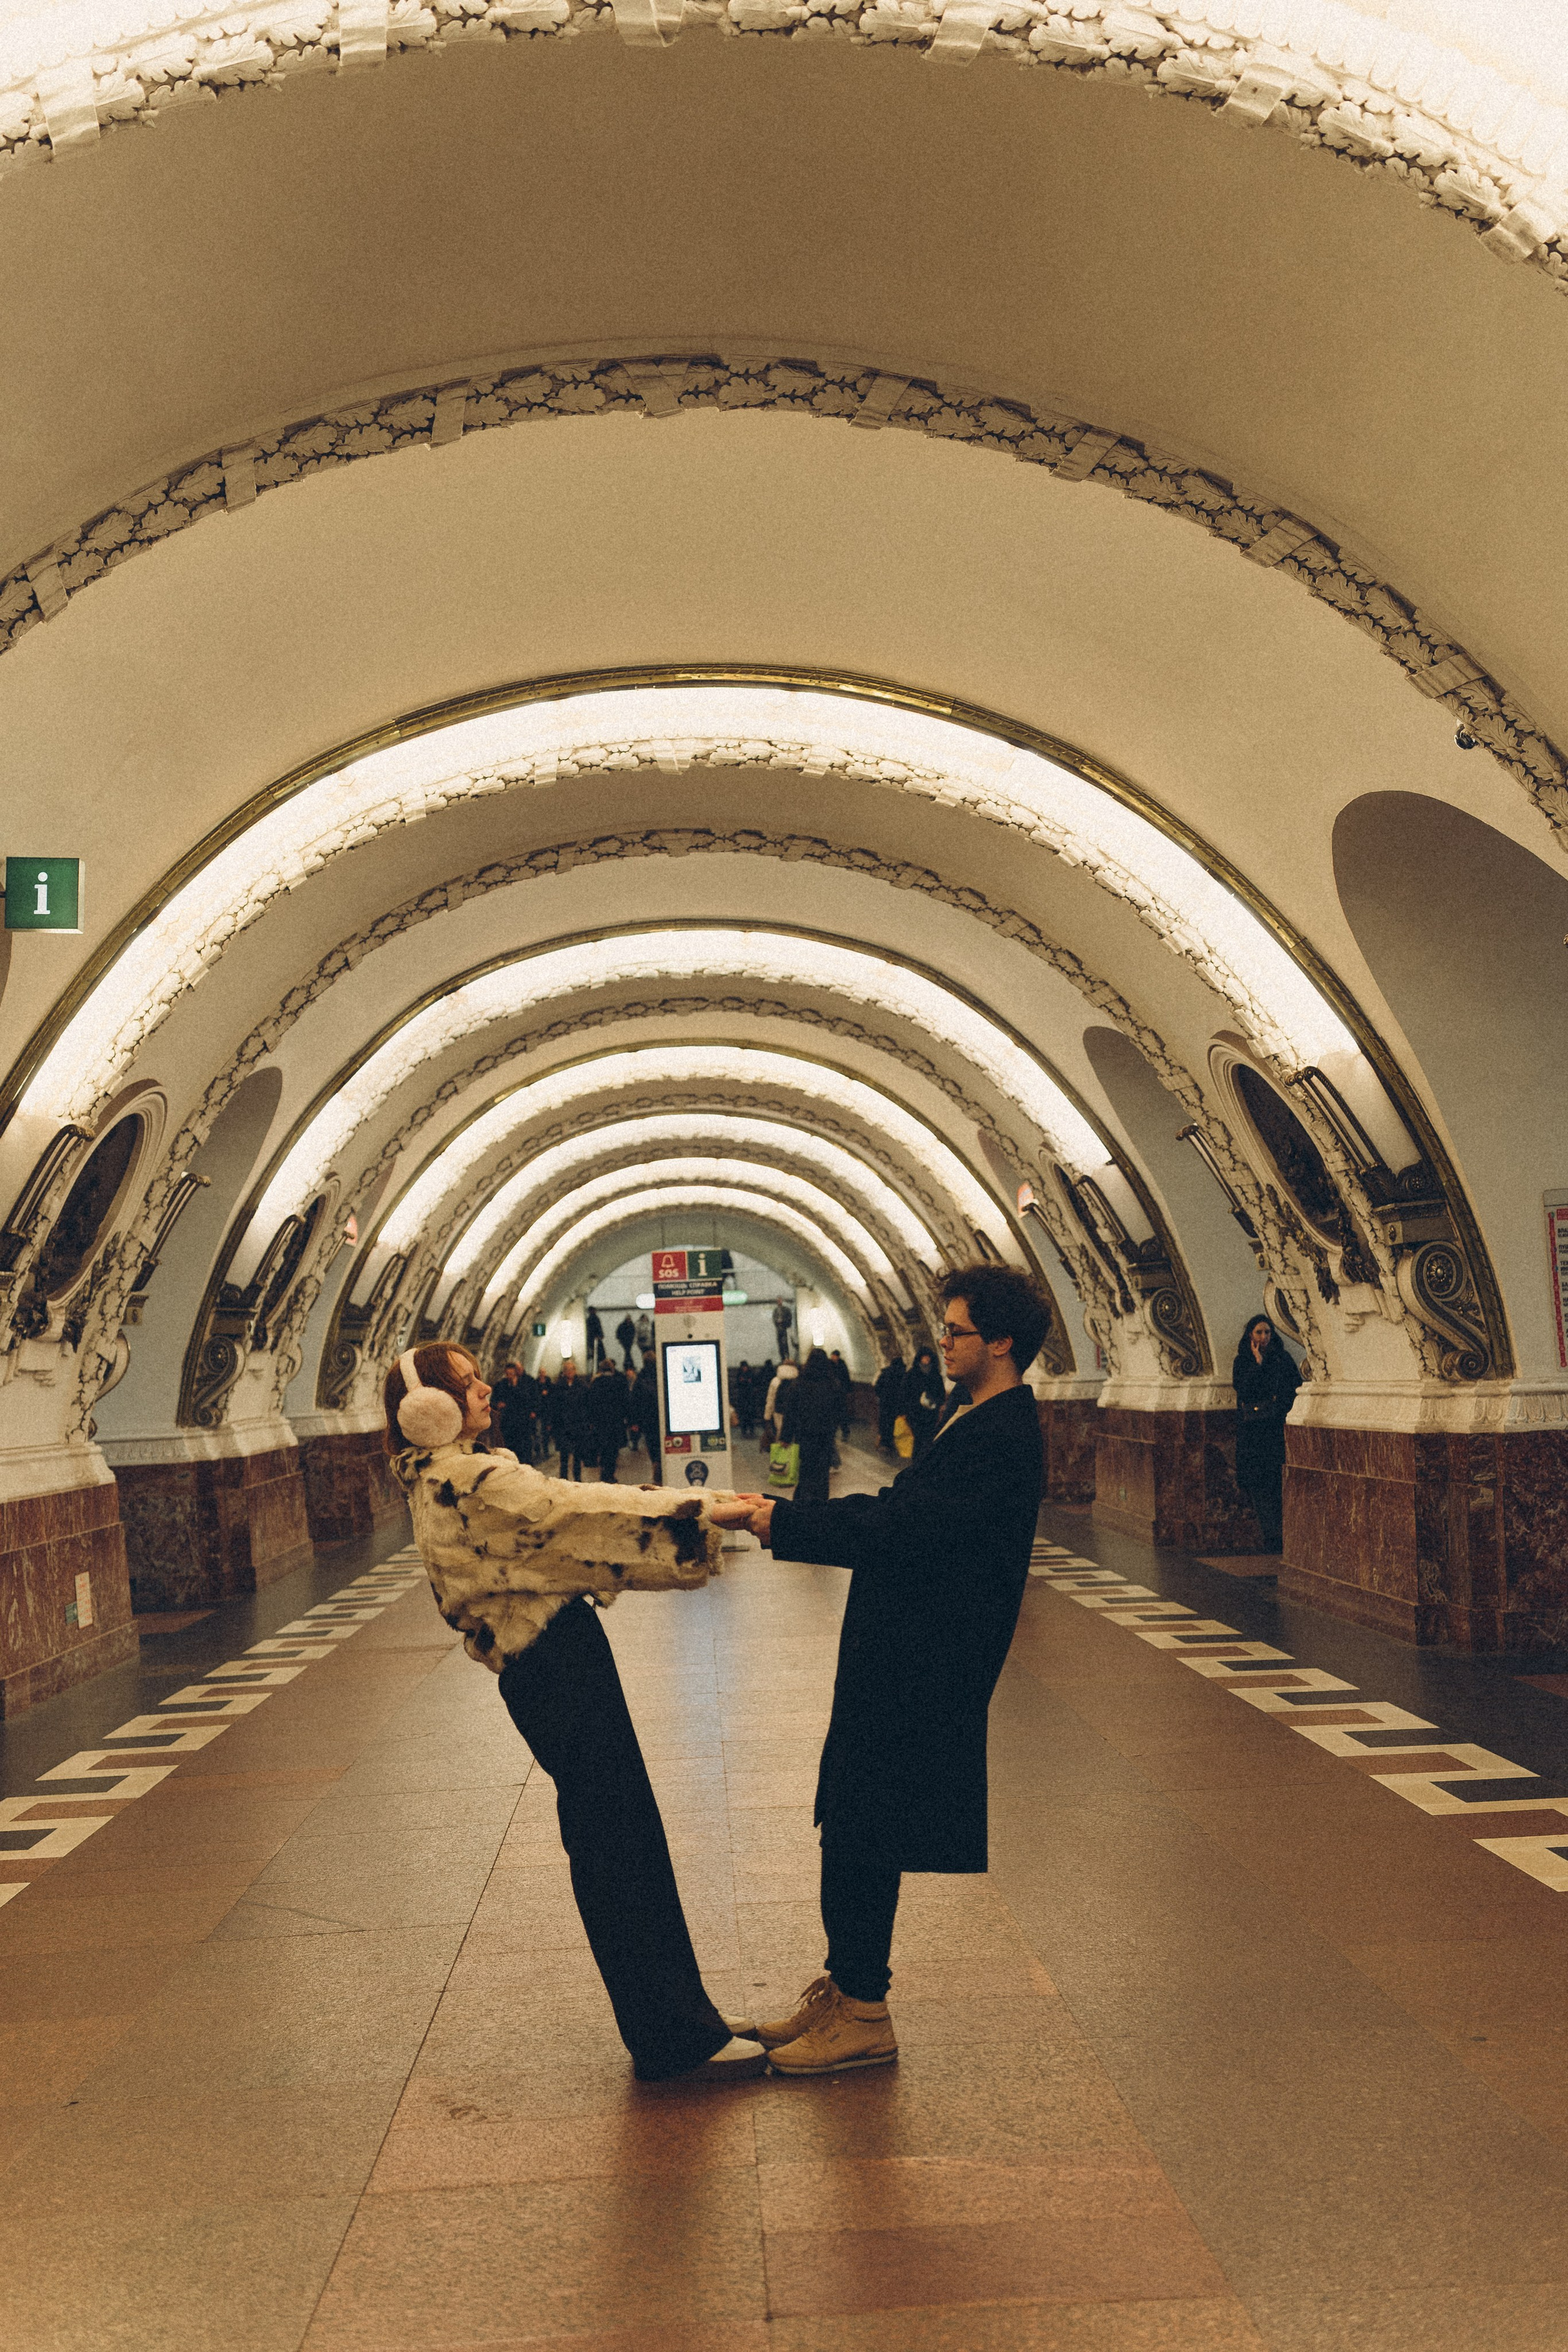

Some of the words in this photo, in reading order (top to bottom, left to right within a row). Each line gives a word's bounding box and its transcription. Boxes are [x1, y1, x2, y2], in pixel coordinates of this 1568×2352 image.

[34, 872, 50, 914] i
[658, 1268, 679, 1278] SOS
[698, 1253, 707, 1276] i
